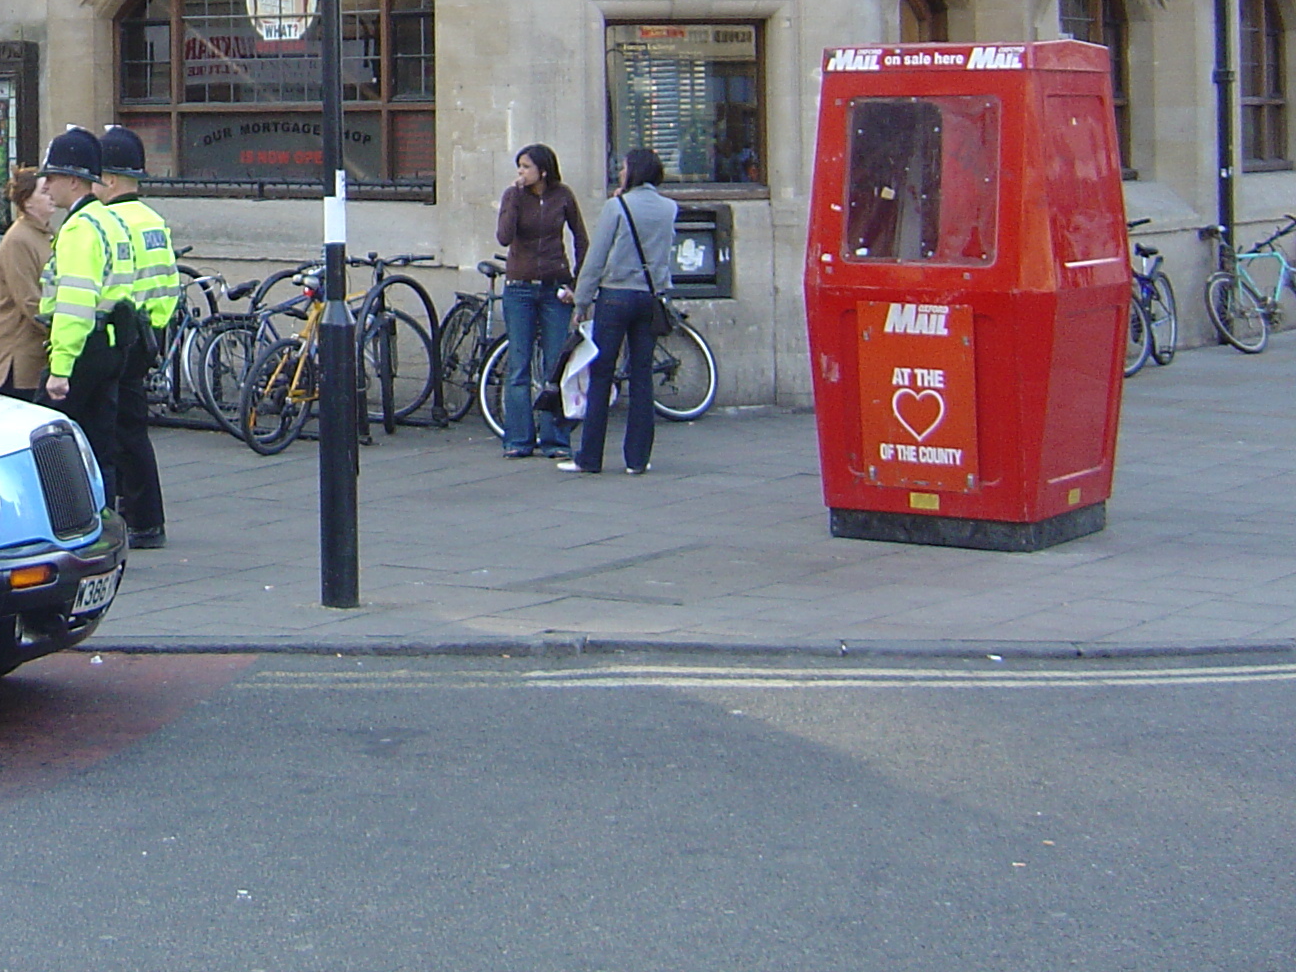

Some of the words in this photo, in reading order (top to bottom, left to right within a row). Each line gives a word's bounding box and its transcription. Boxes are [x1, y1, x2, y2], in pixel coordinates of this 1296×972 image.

[265, 24, 299, 39] WHAT?
[884, 54, 900, 65] on
[904, 53, 931, 65] sale
[934, 52, 963, 65] here
[204, 127, 232, 146] OUR
[240, 121, 321, 136] MORTGAGE
[293, 150, 324, 165] OPE
[892, 367, 912, 386] AT
[913, 368, 945, 388] THE
[879, 443, 895, 460] OF
[895, 444, 918, 462] THE
[918, 446, 962, 466] COUNTY
